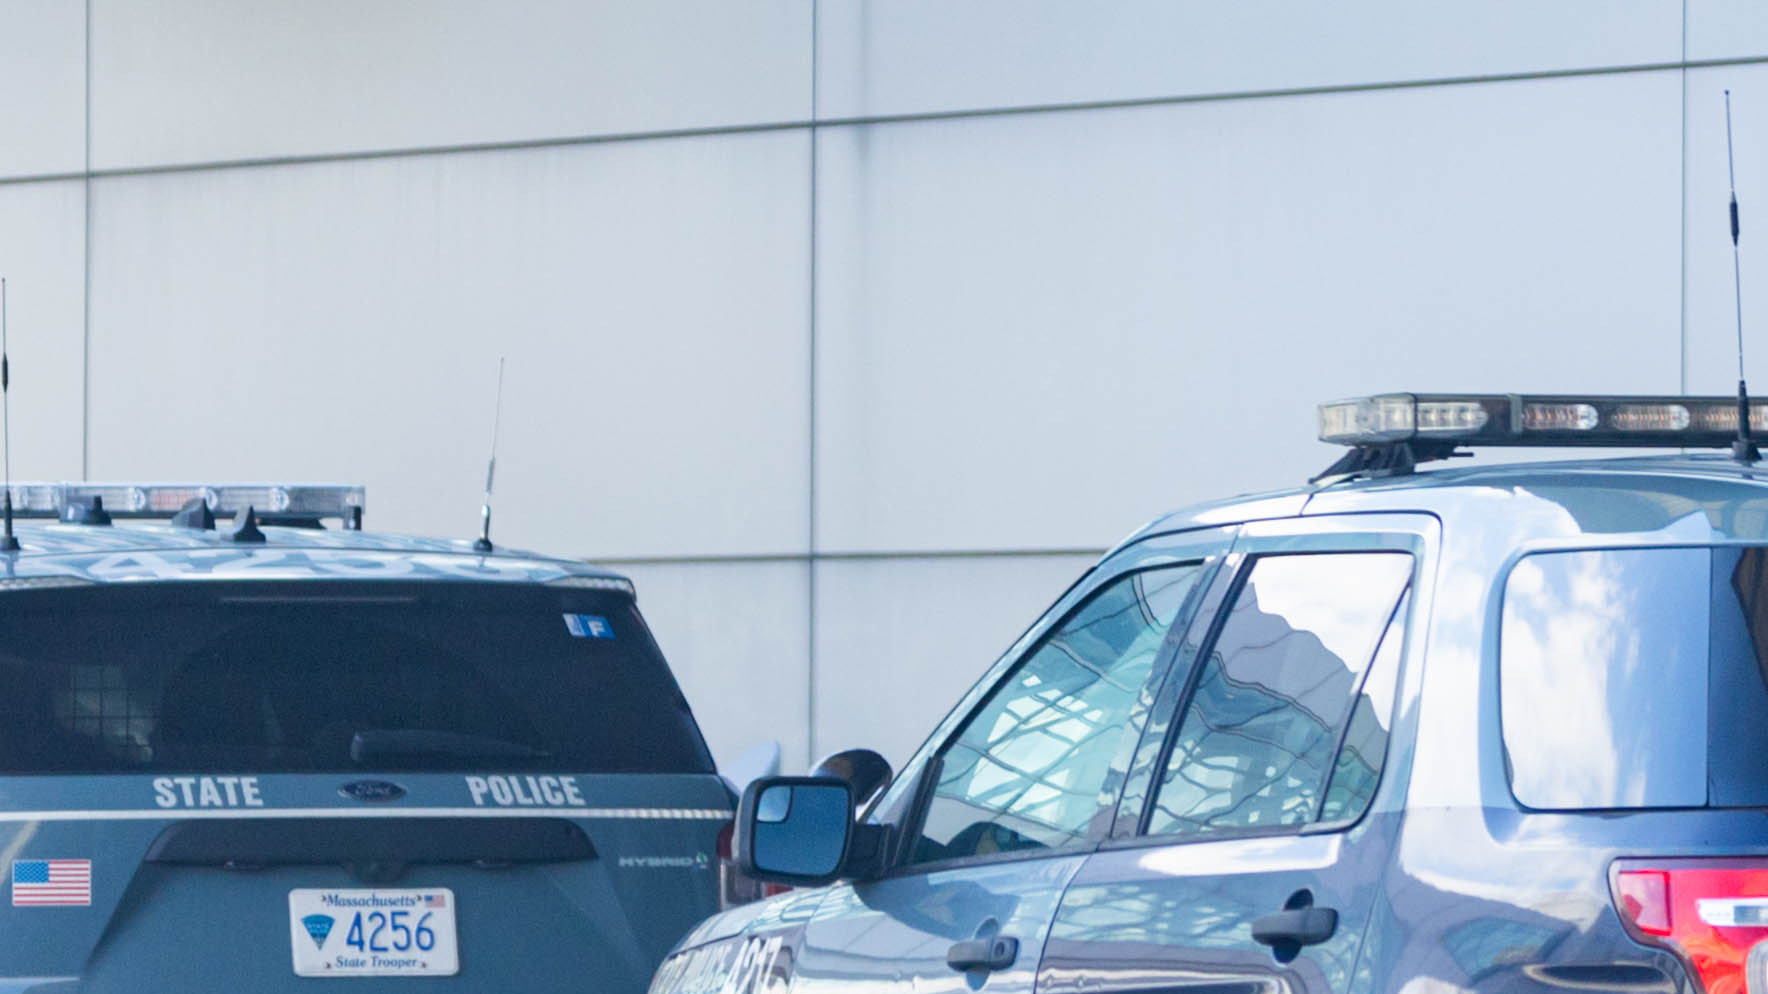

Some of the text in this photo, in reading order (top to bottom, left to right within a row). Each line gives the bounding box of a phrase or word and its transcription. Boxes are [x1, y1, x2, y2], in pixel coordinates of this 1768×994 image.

[587, 620, 606, 637] F
[153, 776, 264, 808] STATE
[465, 775, 586, 806] POLICE
[619, 857, 693, 867] HYBRID
[326, 892, 417, 908] Massachusetts
[346, 910, 435, 952] 4256
[335, 956, 417, 970] State Trooper
